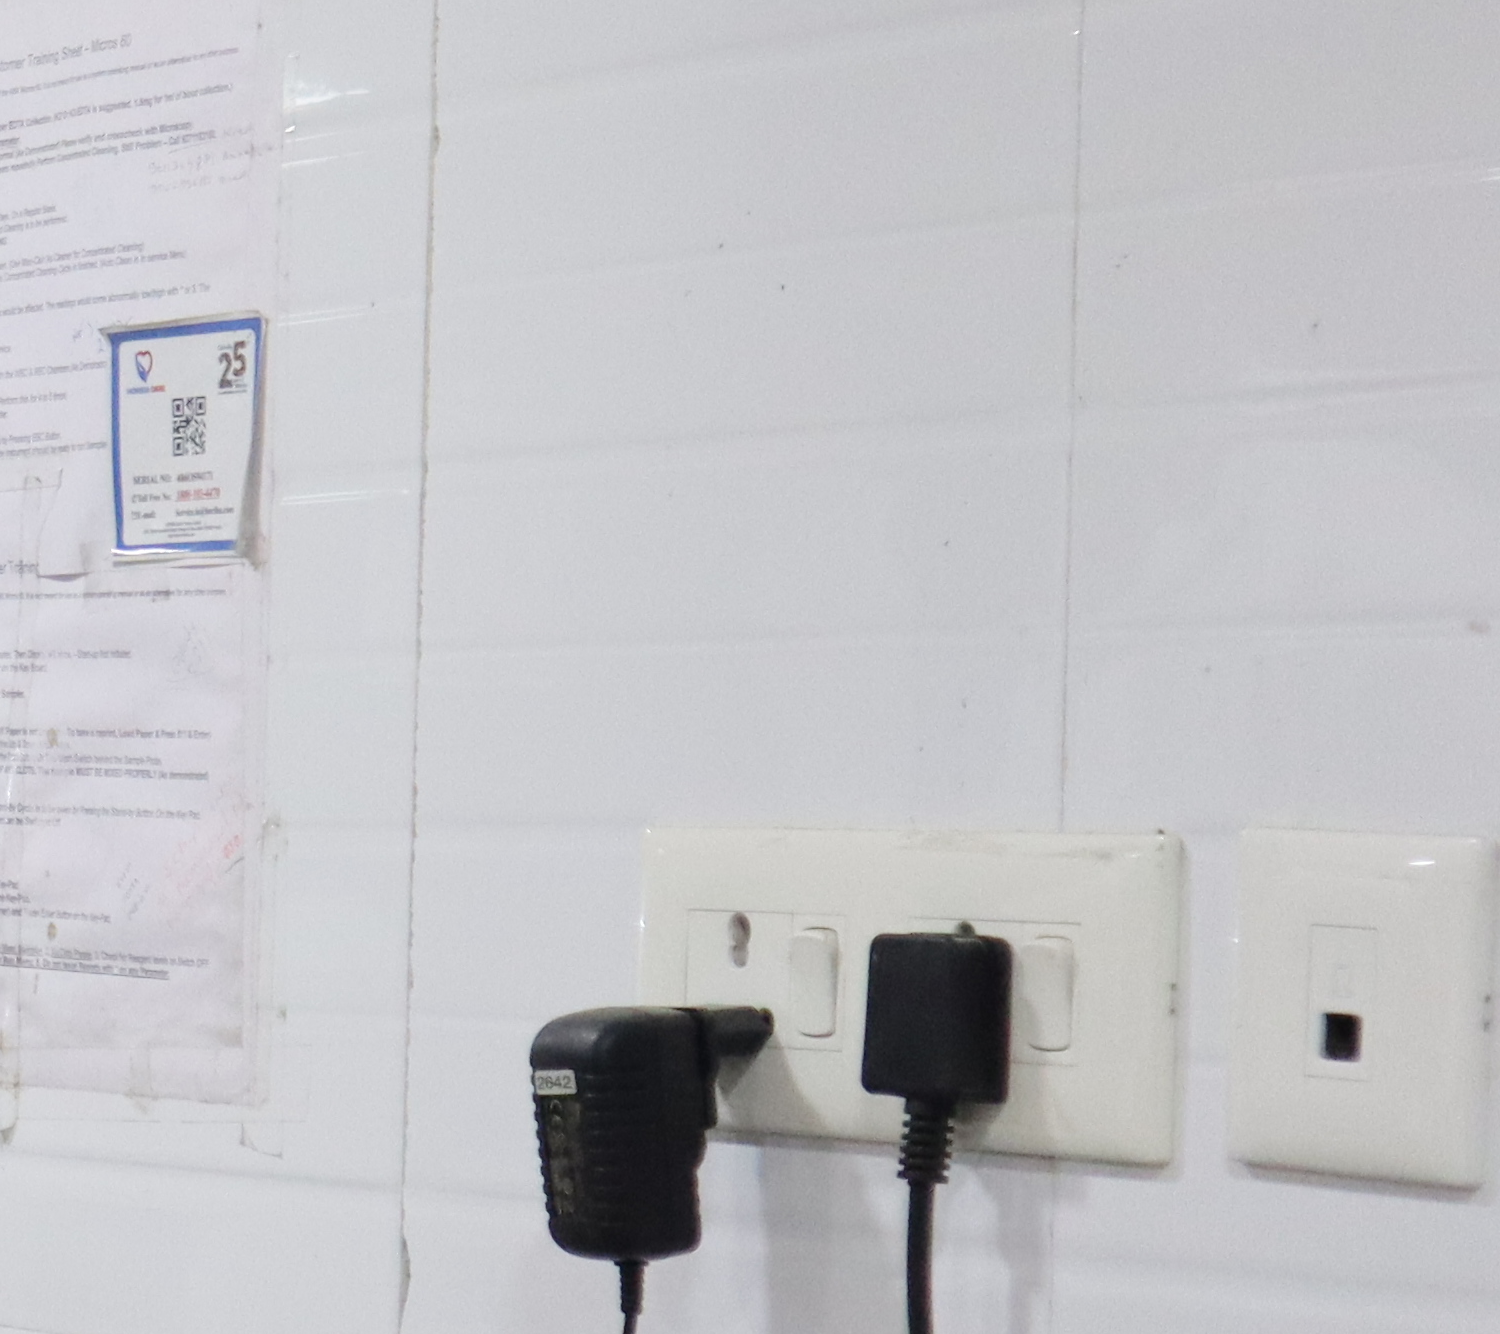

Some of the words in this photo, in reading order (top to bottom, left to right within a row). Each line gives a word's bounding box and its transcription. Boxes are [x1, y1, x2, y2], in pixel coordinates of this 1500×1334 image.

[28, 51, 59, 66] Training
[62, 46, 83, 60] Sheet
[91, 39, 118, 52] Micros
[217, 341, 247, 389] 25
[535, 1074, 573, 1090] 2642
